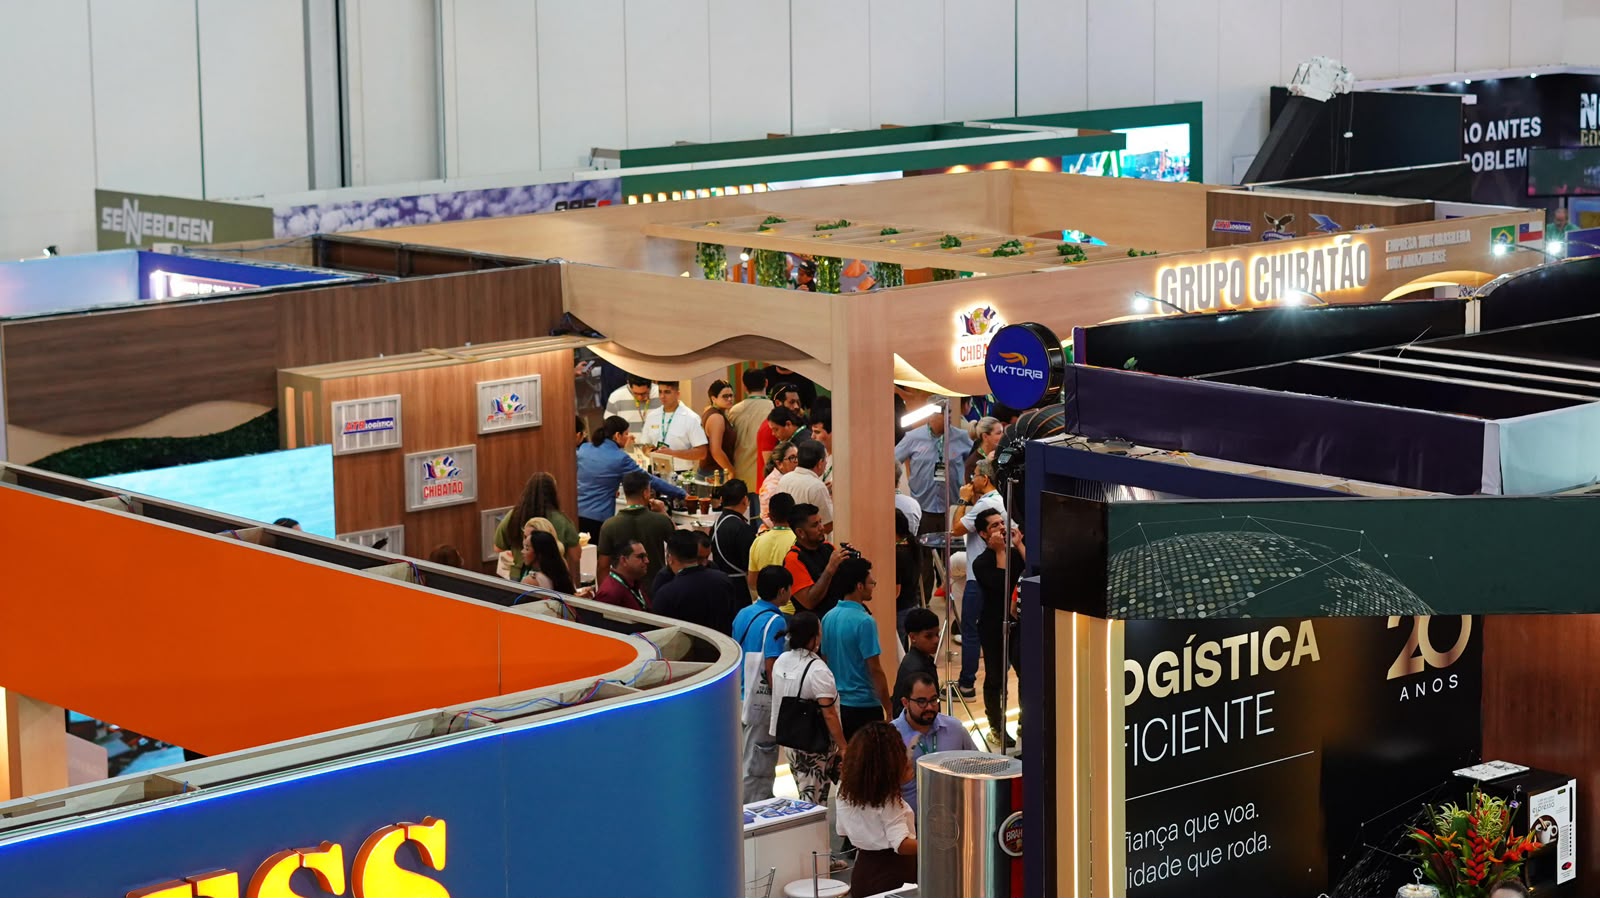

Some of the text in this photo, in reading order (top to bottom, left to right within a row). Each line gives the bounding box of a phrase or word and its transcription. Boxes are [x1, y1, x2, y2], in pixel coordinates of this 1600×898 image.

[1485, 116, 1541, 142] ANTES
[1580, 93, 1600, 129] N
[1160, 235, 1371, 313] GRUPO CHIBATÃO
[423, 480, 464, 500] CHIBATÃO
[1387, 615, 1472, 680] 20
[1399, 674, 1459, 702] ANOS
[1125, 691, 1275, 767] ICIENTE
[1184, 810, 1219, 843] que
[1224, 801, 1260, 823] voa.
[1187, 841, 1223, 877] que
[1227, 831, 1272, 860] roda.
